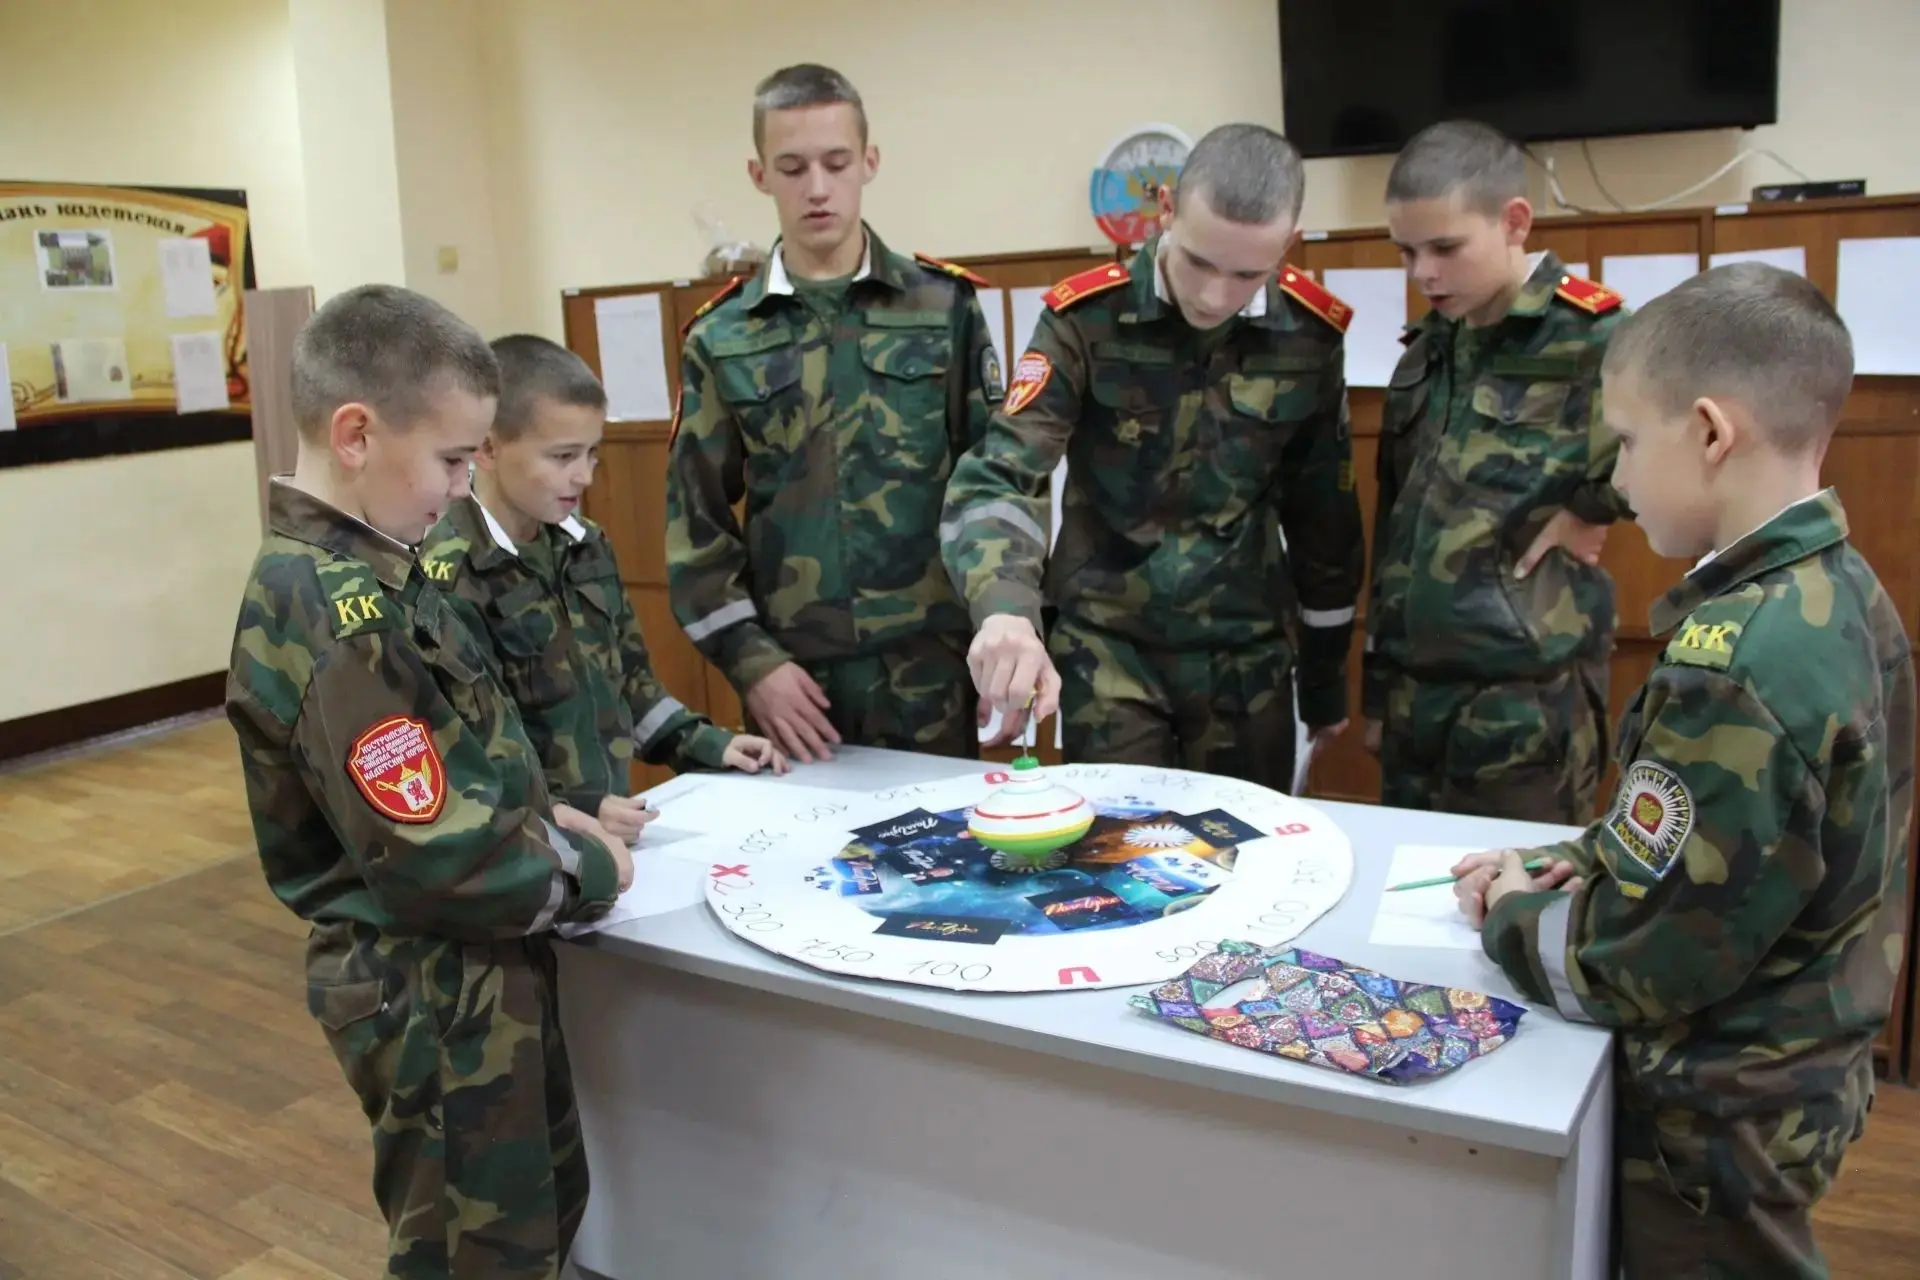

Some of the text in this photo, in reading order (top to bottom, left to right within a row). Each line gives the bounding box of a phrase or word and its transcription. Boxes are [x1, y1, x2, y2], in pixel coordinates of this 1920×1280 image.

[56, 203, 187, 234] кадетская
[424, 560, 454, 580] КК
[336, 595, 383, 624] КК
[1680, 624, 1733, 651] КК
[360, 723, 411, 754] КОСТРОМСКОЙ
[363, 754, 405, 781] КАДЕТСКИЙ
[722, 902, 784, 931] 300
[1247, 900, 1309, 933] 100
[799, 938, 875, 962] 750
[1155, 940, 1219, 965] 500
[908, 959, 992, 982] 100
